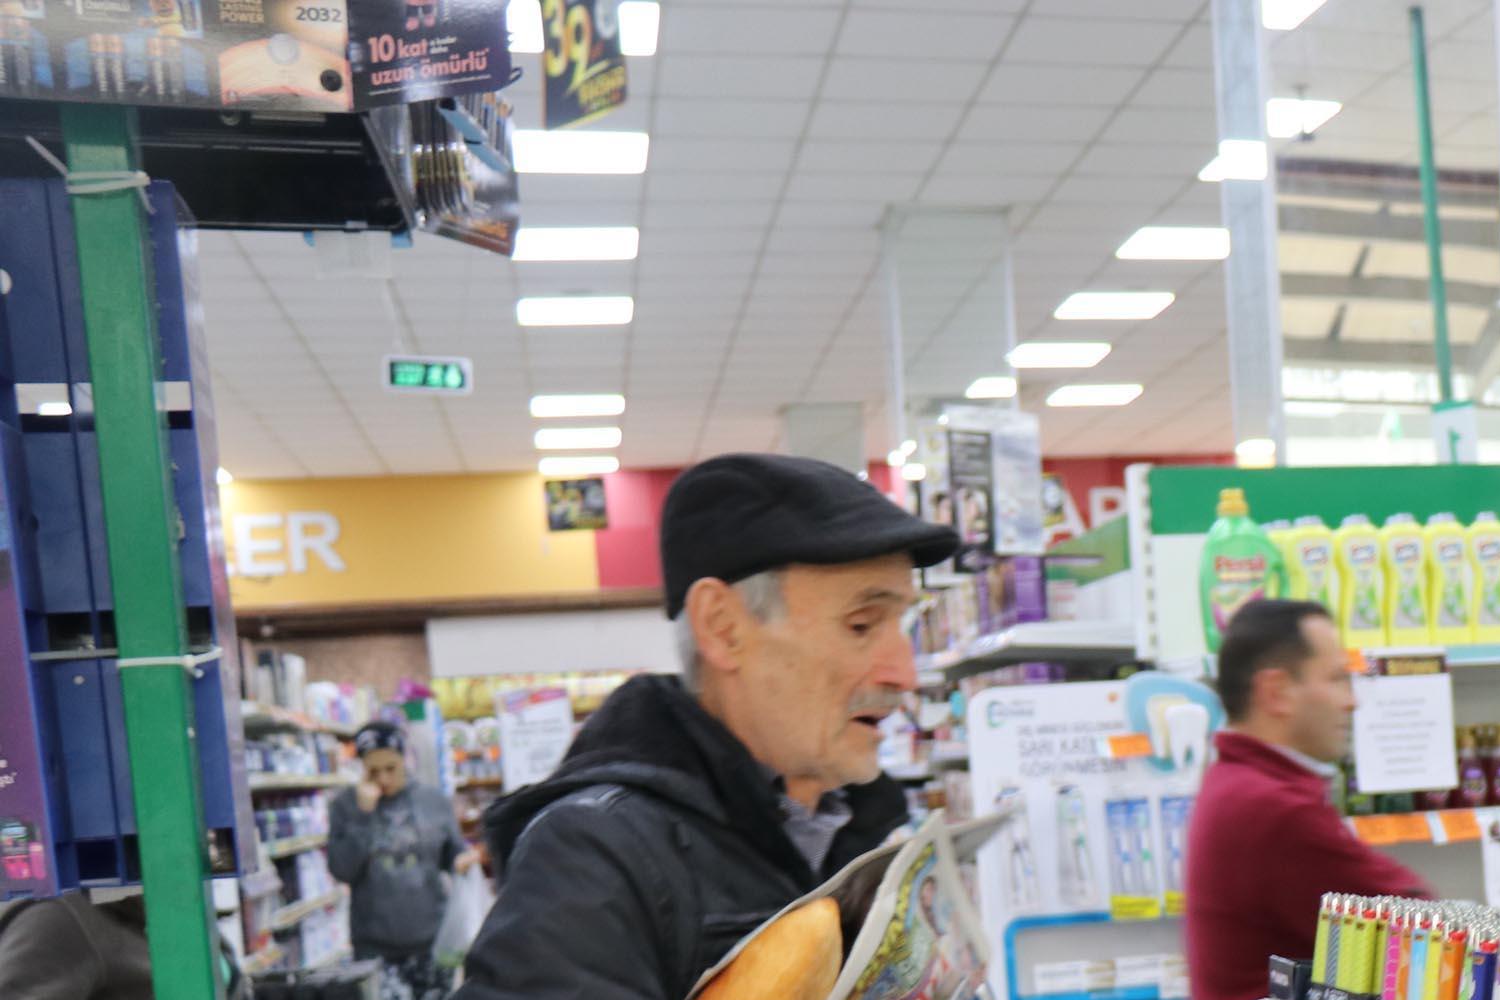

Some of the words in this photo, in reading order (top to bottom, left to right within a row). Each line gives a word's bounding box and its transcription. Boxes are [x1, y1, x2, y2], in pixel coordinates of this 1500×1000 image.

[296, 6, 342, 22] 2032
[368, 34, 395, 63] 10
[397, 38, 429, 57] kat
[371, 64, 414, 86] uzun
[226, 511, 346, 578] ER
